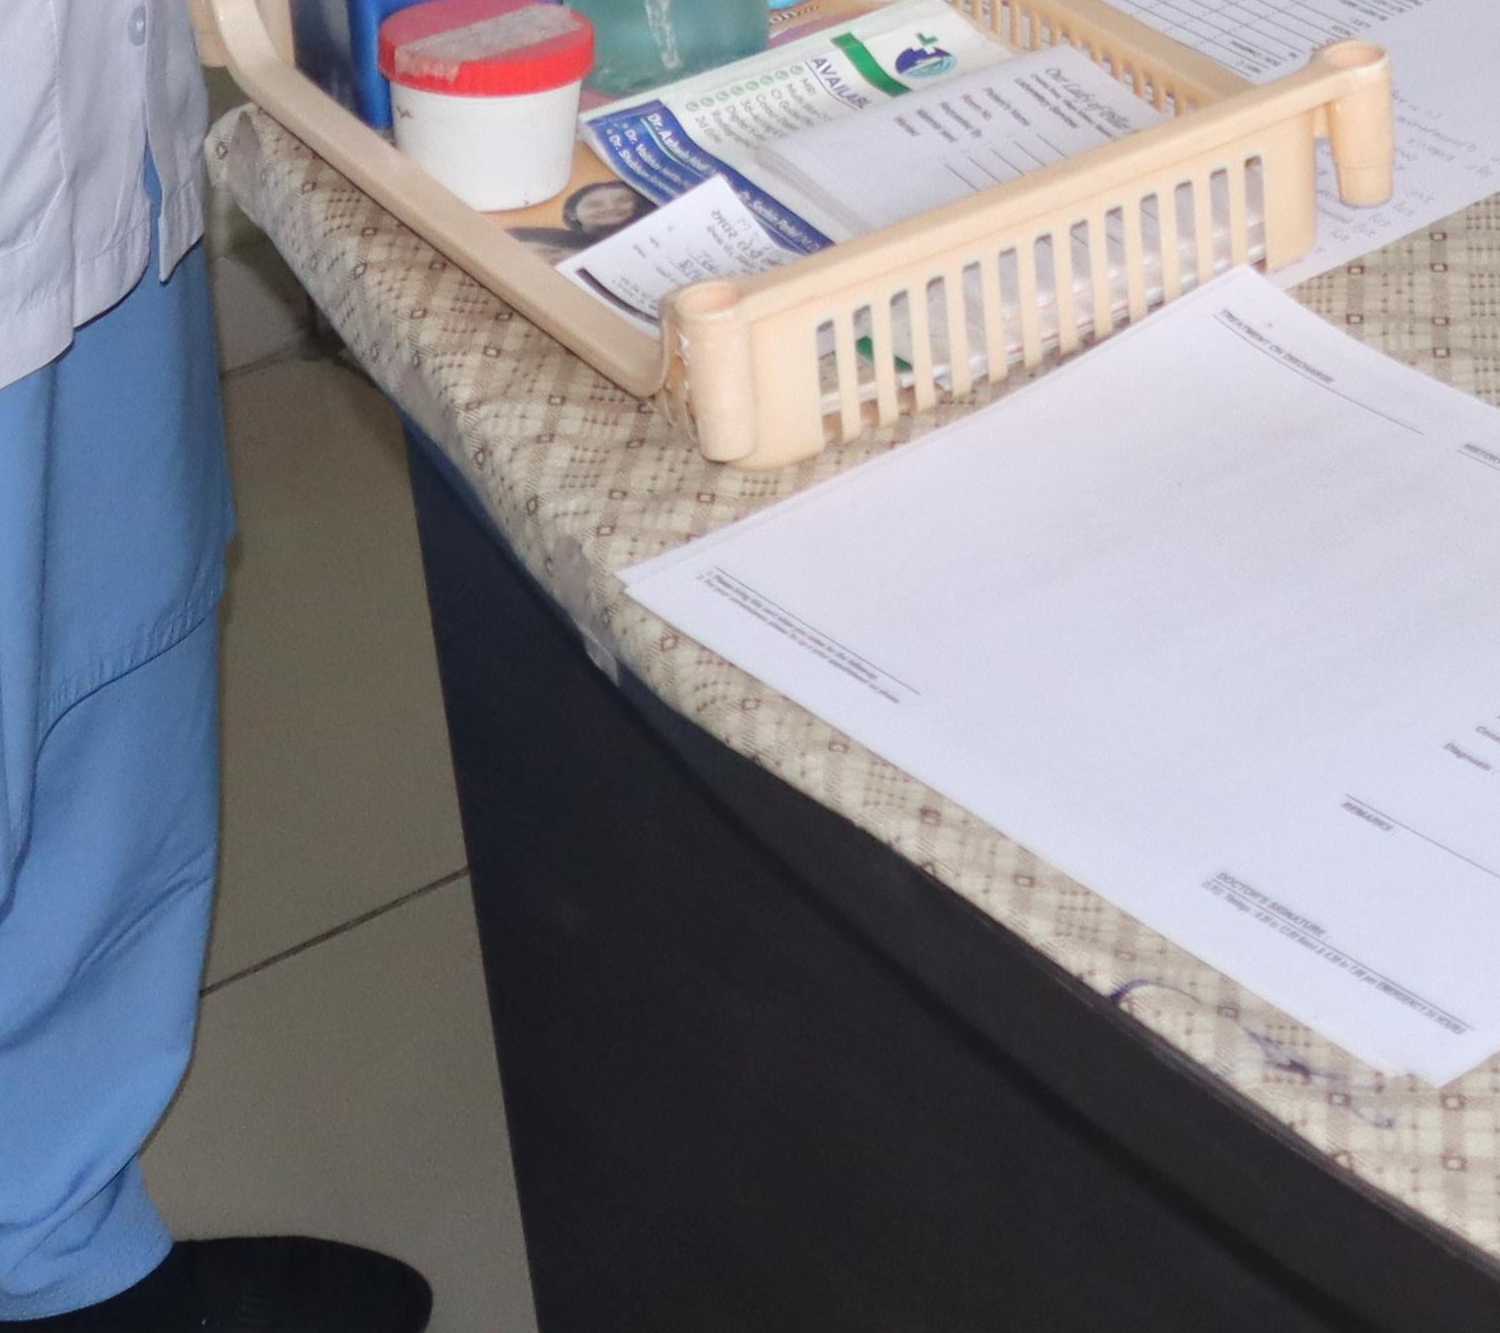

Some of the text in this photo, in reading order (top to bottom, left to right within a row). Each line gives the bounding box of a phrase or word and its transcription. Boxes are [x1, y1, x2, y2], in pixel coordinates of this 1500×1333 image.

[647, 113, 664, 130] Dr.
[609, 134, 622, 150] Dr.
[624, 129, 638, 144] Dr.
